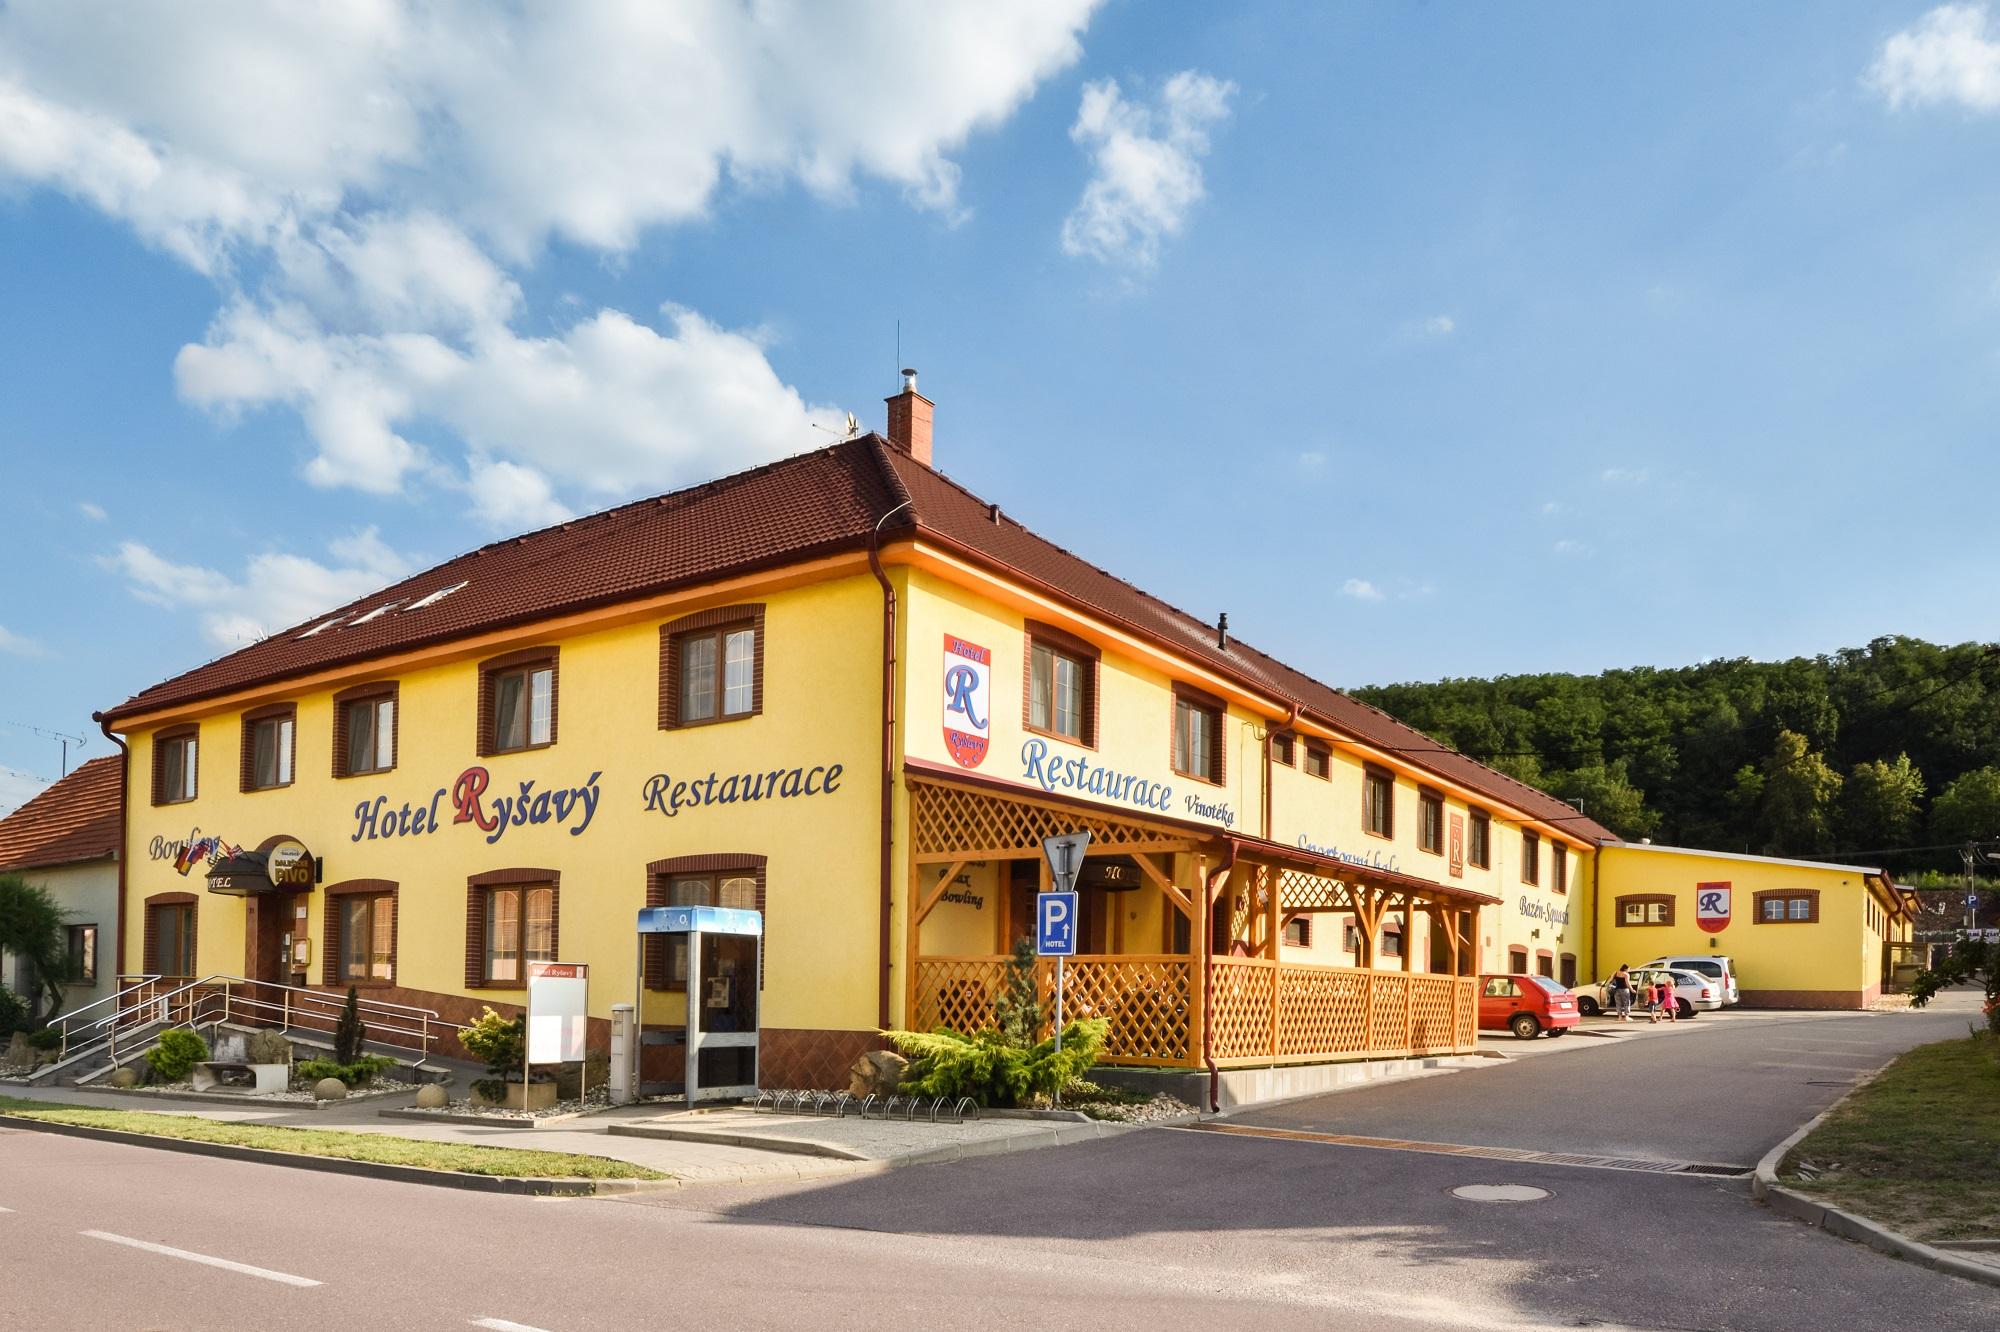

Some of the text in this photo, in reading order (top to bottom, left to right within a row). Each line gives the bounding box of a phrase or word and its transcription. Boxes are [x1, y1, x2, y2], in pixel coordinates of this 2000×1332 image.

[953, 640, 985, 661] Hotel
[946, 665, 988, 730] R
[642, 763, 844, 817] Restaurace
[1021, 738, 1173, 811] Restaurace
[351, 766, 603, 844] Hotel Ryšavý
[1185, 794, 1234, 828] Vinotéka
[275, 868, 309, 883] PIVO
[1699, 892, 1729, 915] R
[1968, 895, 1977, 905] P
[1045, 900, 1068, 936] P
[1045, 940, 1066, 948] HOTEL
